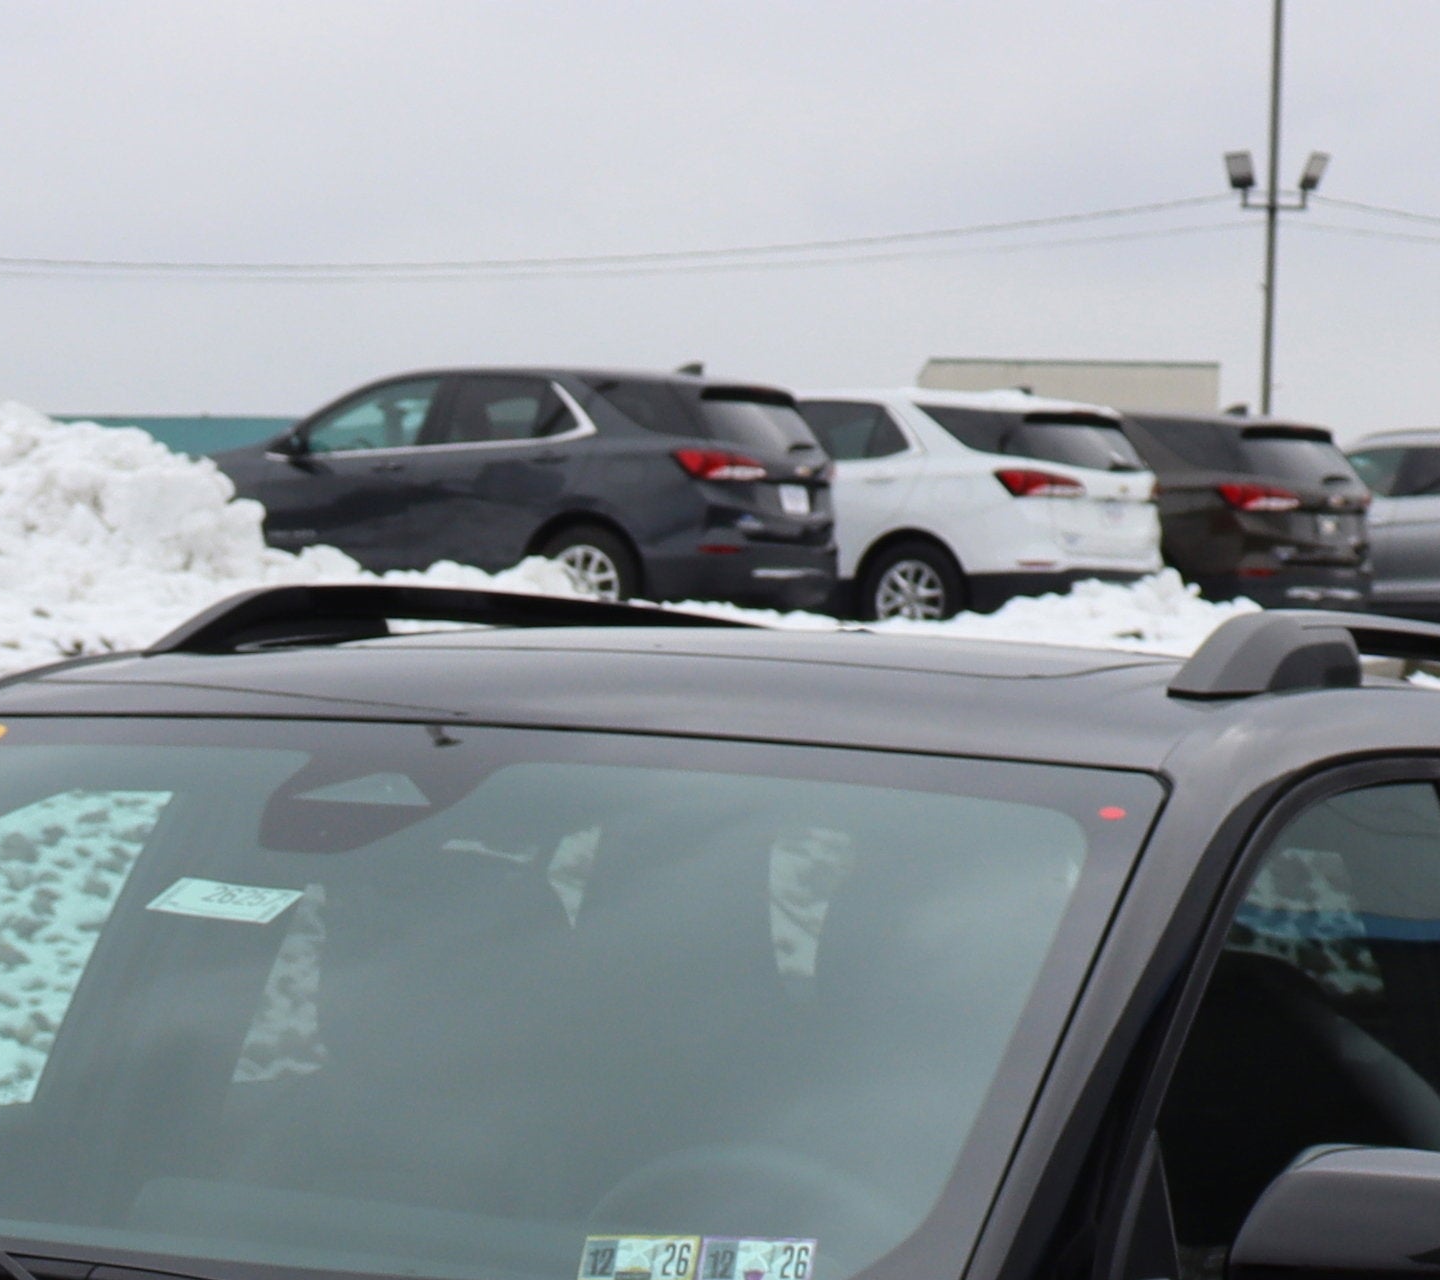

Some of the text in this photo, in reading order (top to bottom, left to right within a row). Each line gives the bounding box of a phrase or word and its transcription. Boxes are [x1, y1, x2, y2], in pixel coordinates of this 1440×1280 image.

[588, 1242, 692, 1277] 12 26
[708, 1245, 810, 1280] 12 26
